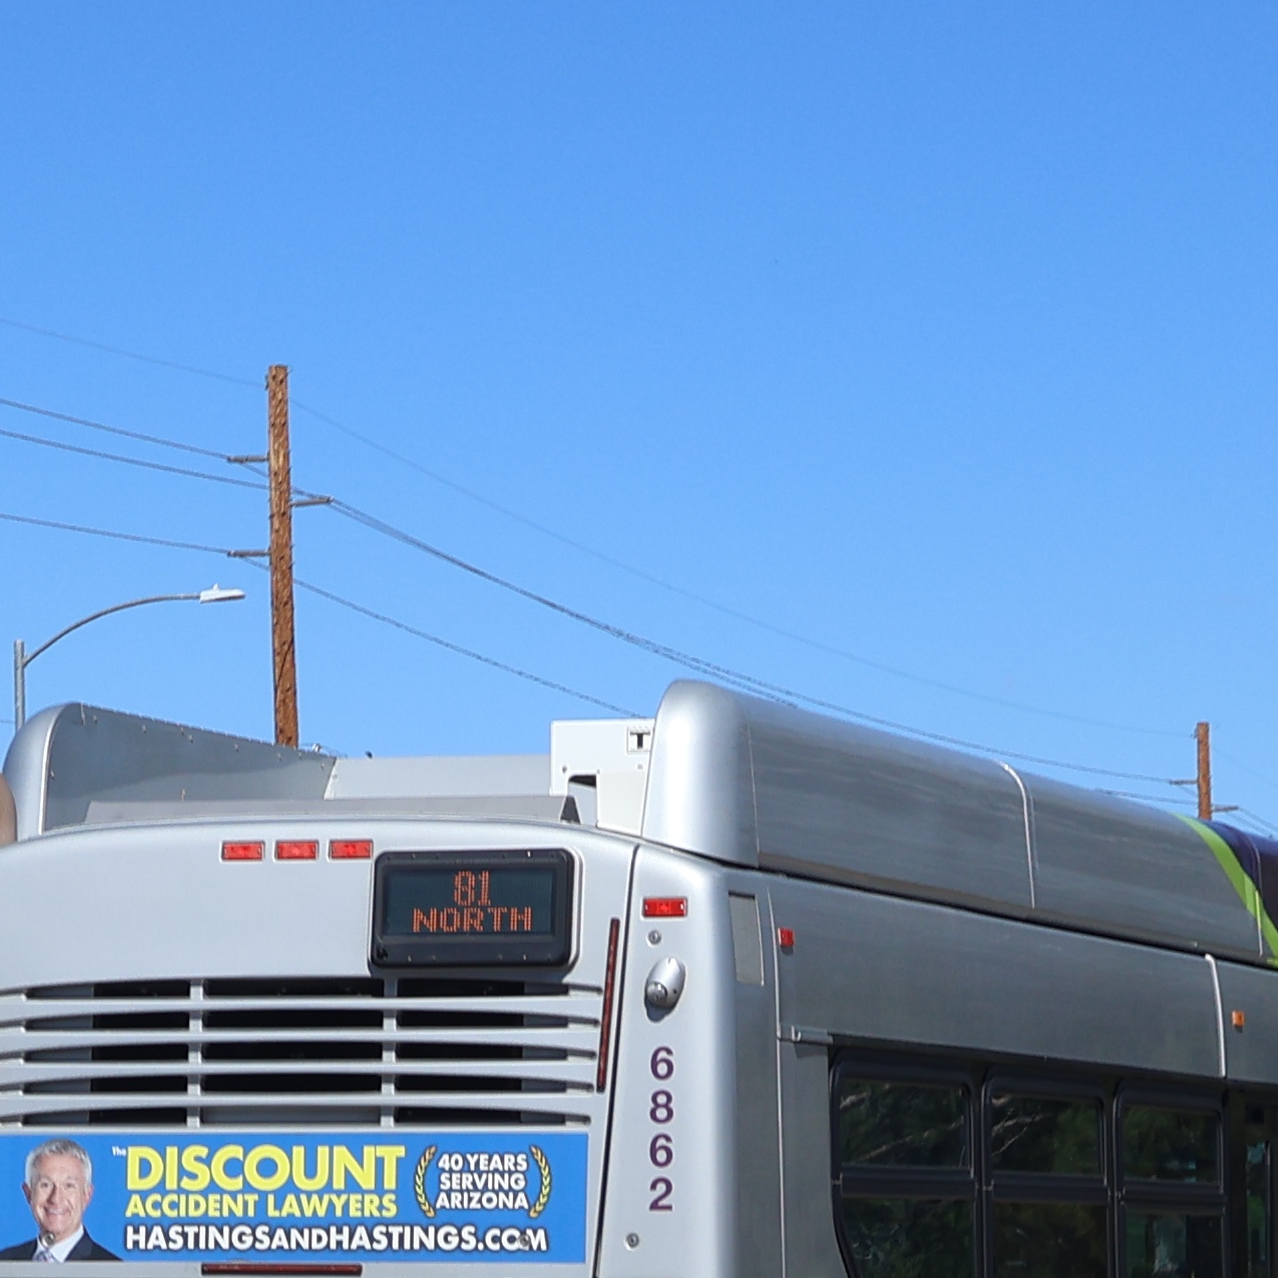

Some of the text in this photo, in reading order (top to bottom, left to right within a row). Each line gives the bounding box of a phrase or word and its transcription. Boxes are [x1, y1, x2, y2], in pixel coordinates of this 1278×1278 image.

[454, 870, 491, 906] 81
[412, 906, 533, 933] NORTH
[649, 1046, 674, 1212] 6862
[112, 1144, 406, 1191] The DISCOUNT
[438, 1153, 528, 1172] 40 YEARS
[440, 1172, 526, 1191] SERVING
[125, 1193, 398, 1218] ACCIDENT LAWYERS
[436, 1191, 529, 1210] ARIZONA
[125, 1224, 548, 1251] HASTINGSANDHASTINGS.COM
